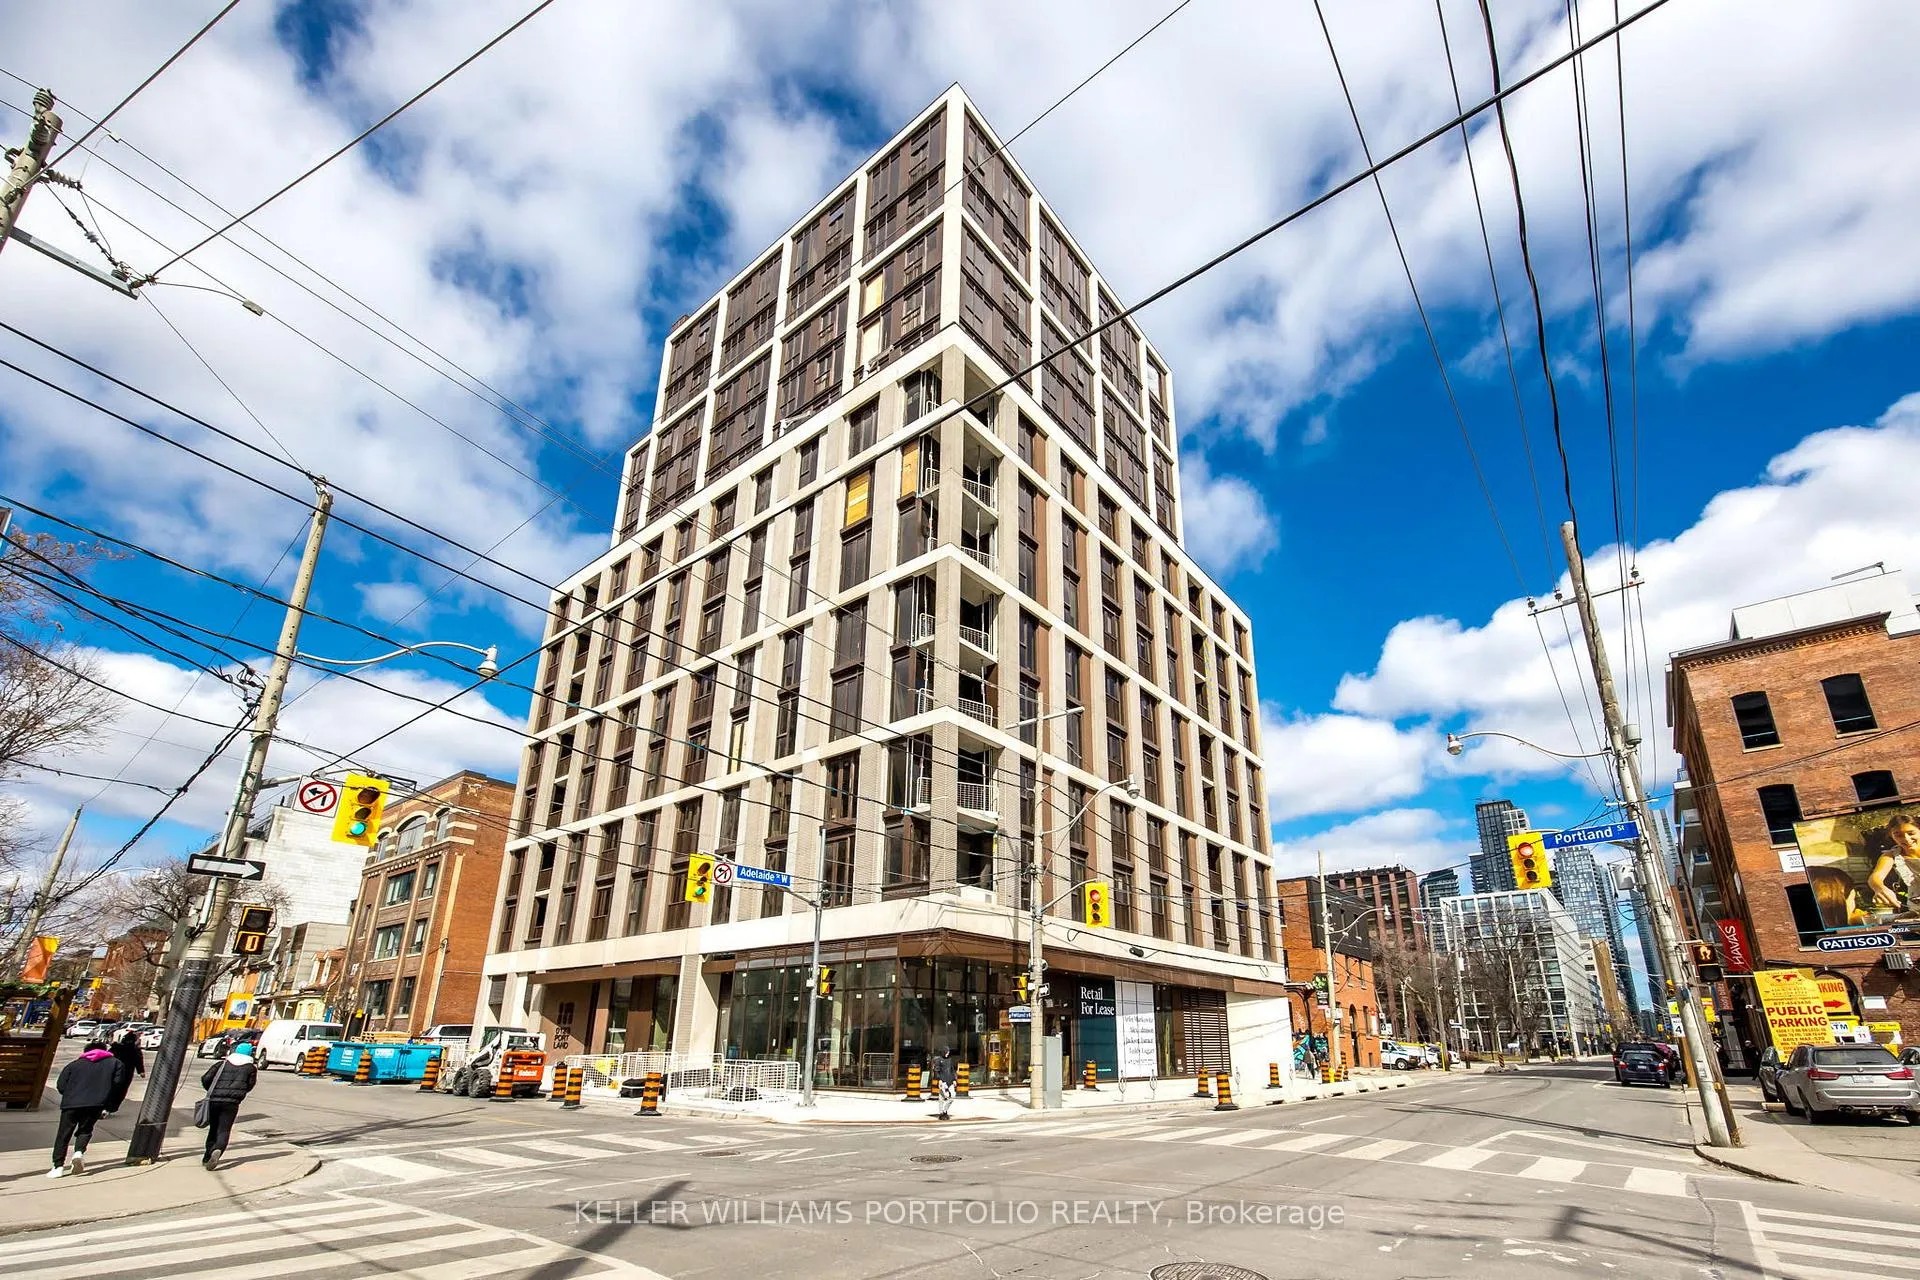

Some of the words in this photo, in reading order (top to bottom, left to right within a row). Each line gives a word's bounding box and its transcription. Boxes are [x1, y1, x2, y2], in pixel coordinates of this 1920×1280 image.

[1554, 826, 1613, 845] Portland
[740, 867, 775, 881] Adelaide
[781, 874, 788, 883] W
[1724, 925, 1745, 965] HAVAS
[1822, 935, 1890, 950] PATTISON
[1080, 986, 1103, 1000] Retail
[1818, 982, 1845, 993] KING
[1081, 1001, 1094, 1015] For
[1095, 1002, 1115, 1016] Lease
[1766, 1005, 1824, 1017] PUBLIC
[1769, 1016, 1828, 1028] PARKING
[553, 1041, 569, 1050] LAND
